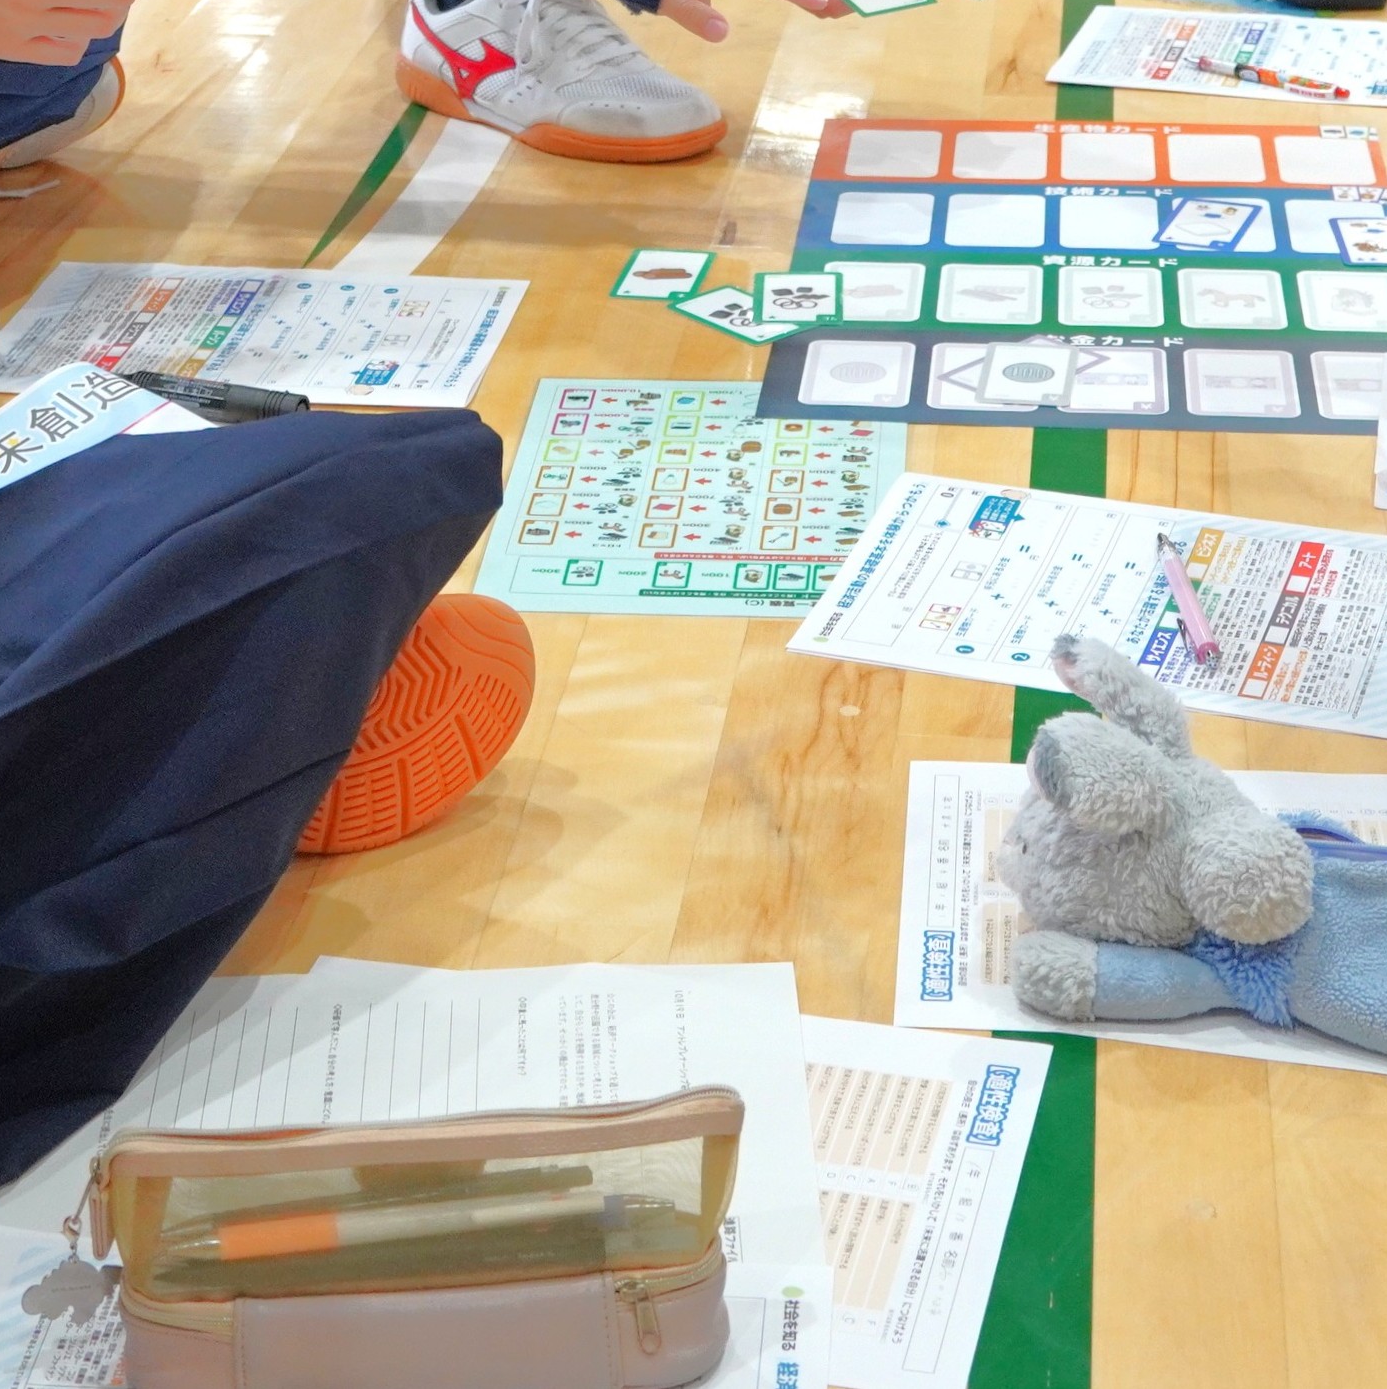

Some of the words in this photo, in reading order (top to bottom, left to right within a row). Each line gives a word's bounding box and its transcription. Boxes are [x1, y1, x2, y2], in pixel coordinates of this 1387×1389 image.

[1033, 124, 1182, 134] 生産物カード
[1044, 186, 1174, 197] 技術カード
[1042, 255, 1179, 267] 資源カード
[817, 611, 845, 637] 社会を知る
[834, 482, 929, 609] 経済活動の基礎基本を体験からつかもう
[1192, 531, 1219, 557] ビジネス
[1297, 550, 1318, 569] アート
[1274, 594, 1300, 625] テクニカル
[1145, 630, 1173, 662] サイエンス
[1252, 644, 1280, 679] ルーティーン
[920, 930, 955, 1001] 【適性検査】
[673, 989, 686, 1018] 10月19日
[965, 1065, 1020, 1146] 【適性検査】
[781, 1300, 800, 1352] 社会を知る
